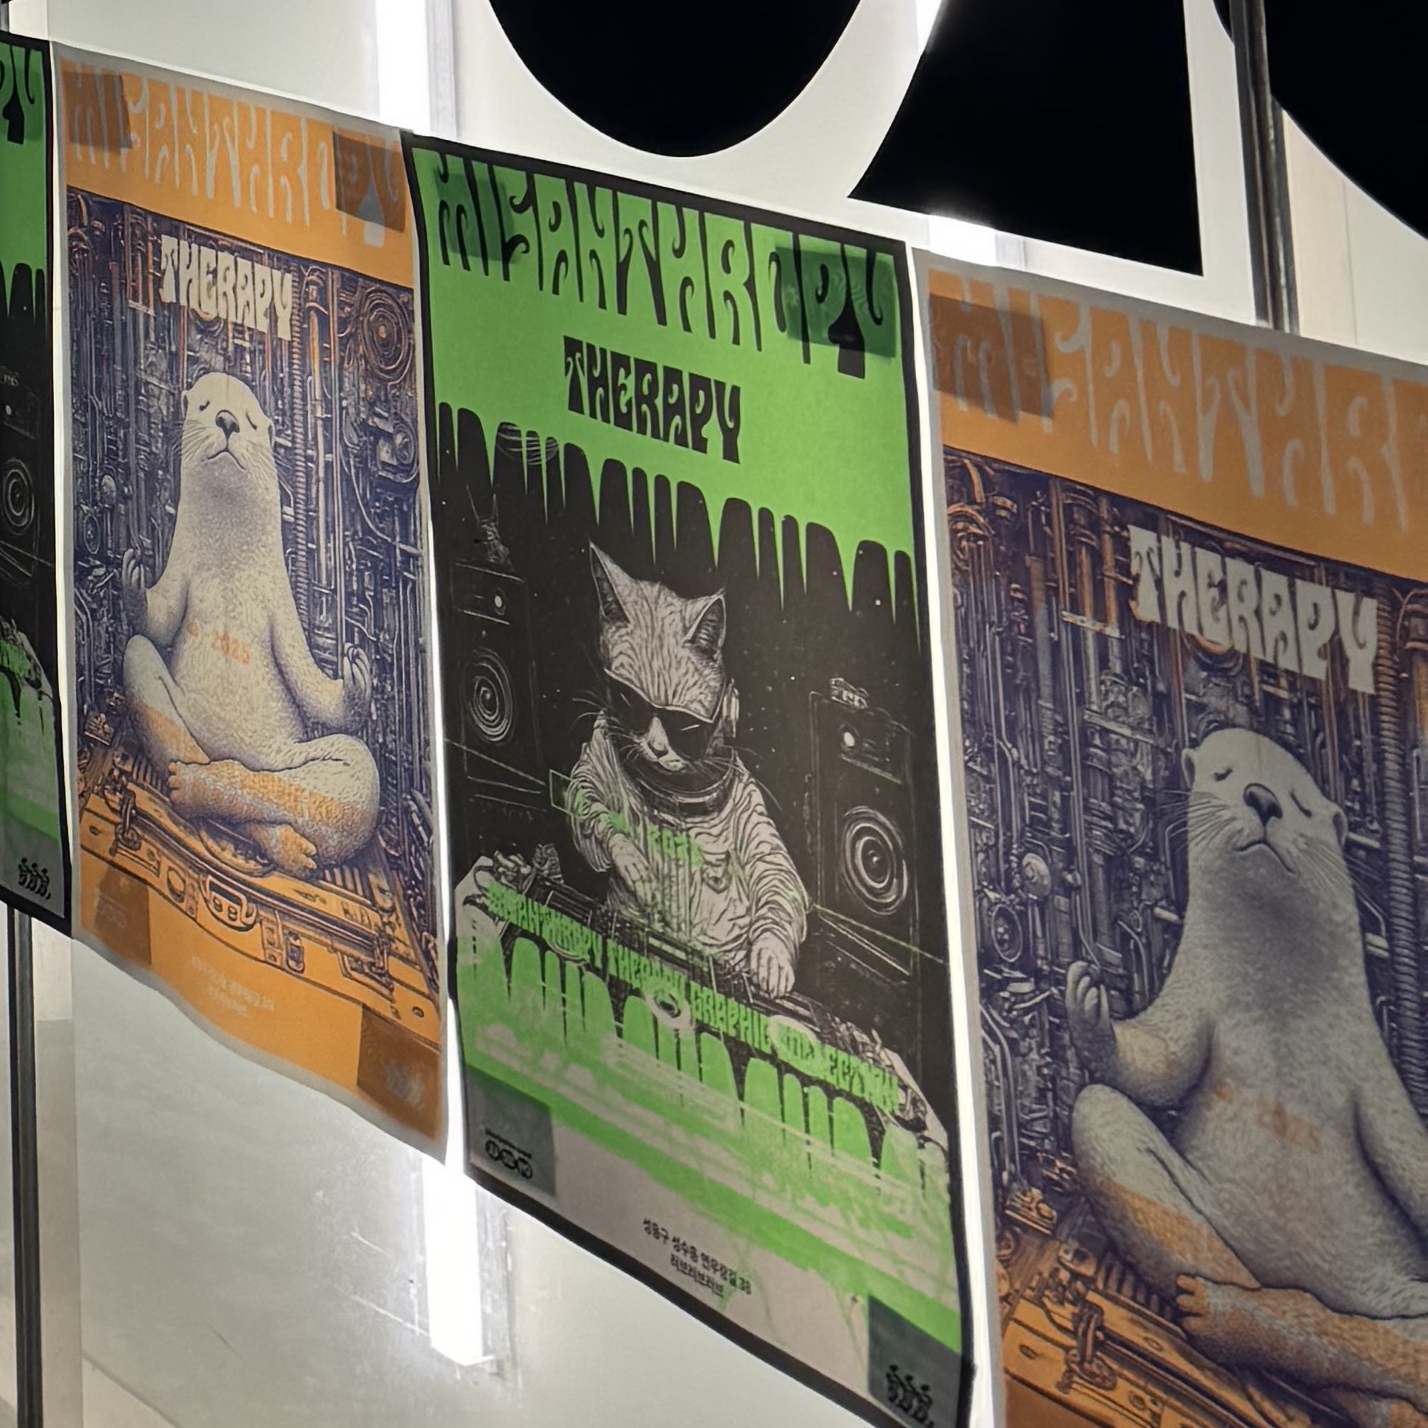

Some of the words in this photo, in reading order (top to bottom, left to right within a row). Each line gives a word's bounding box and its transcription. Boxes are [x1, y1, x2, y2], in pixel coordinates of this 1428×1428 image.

[160, 234, 293, 341] THERAPY
[563, 334, 742, 465] THERAPY
[1127, 524, 1378, 695] THERAPY
